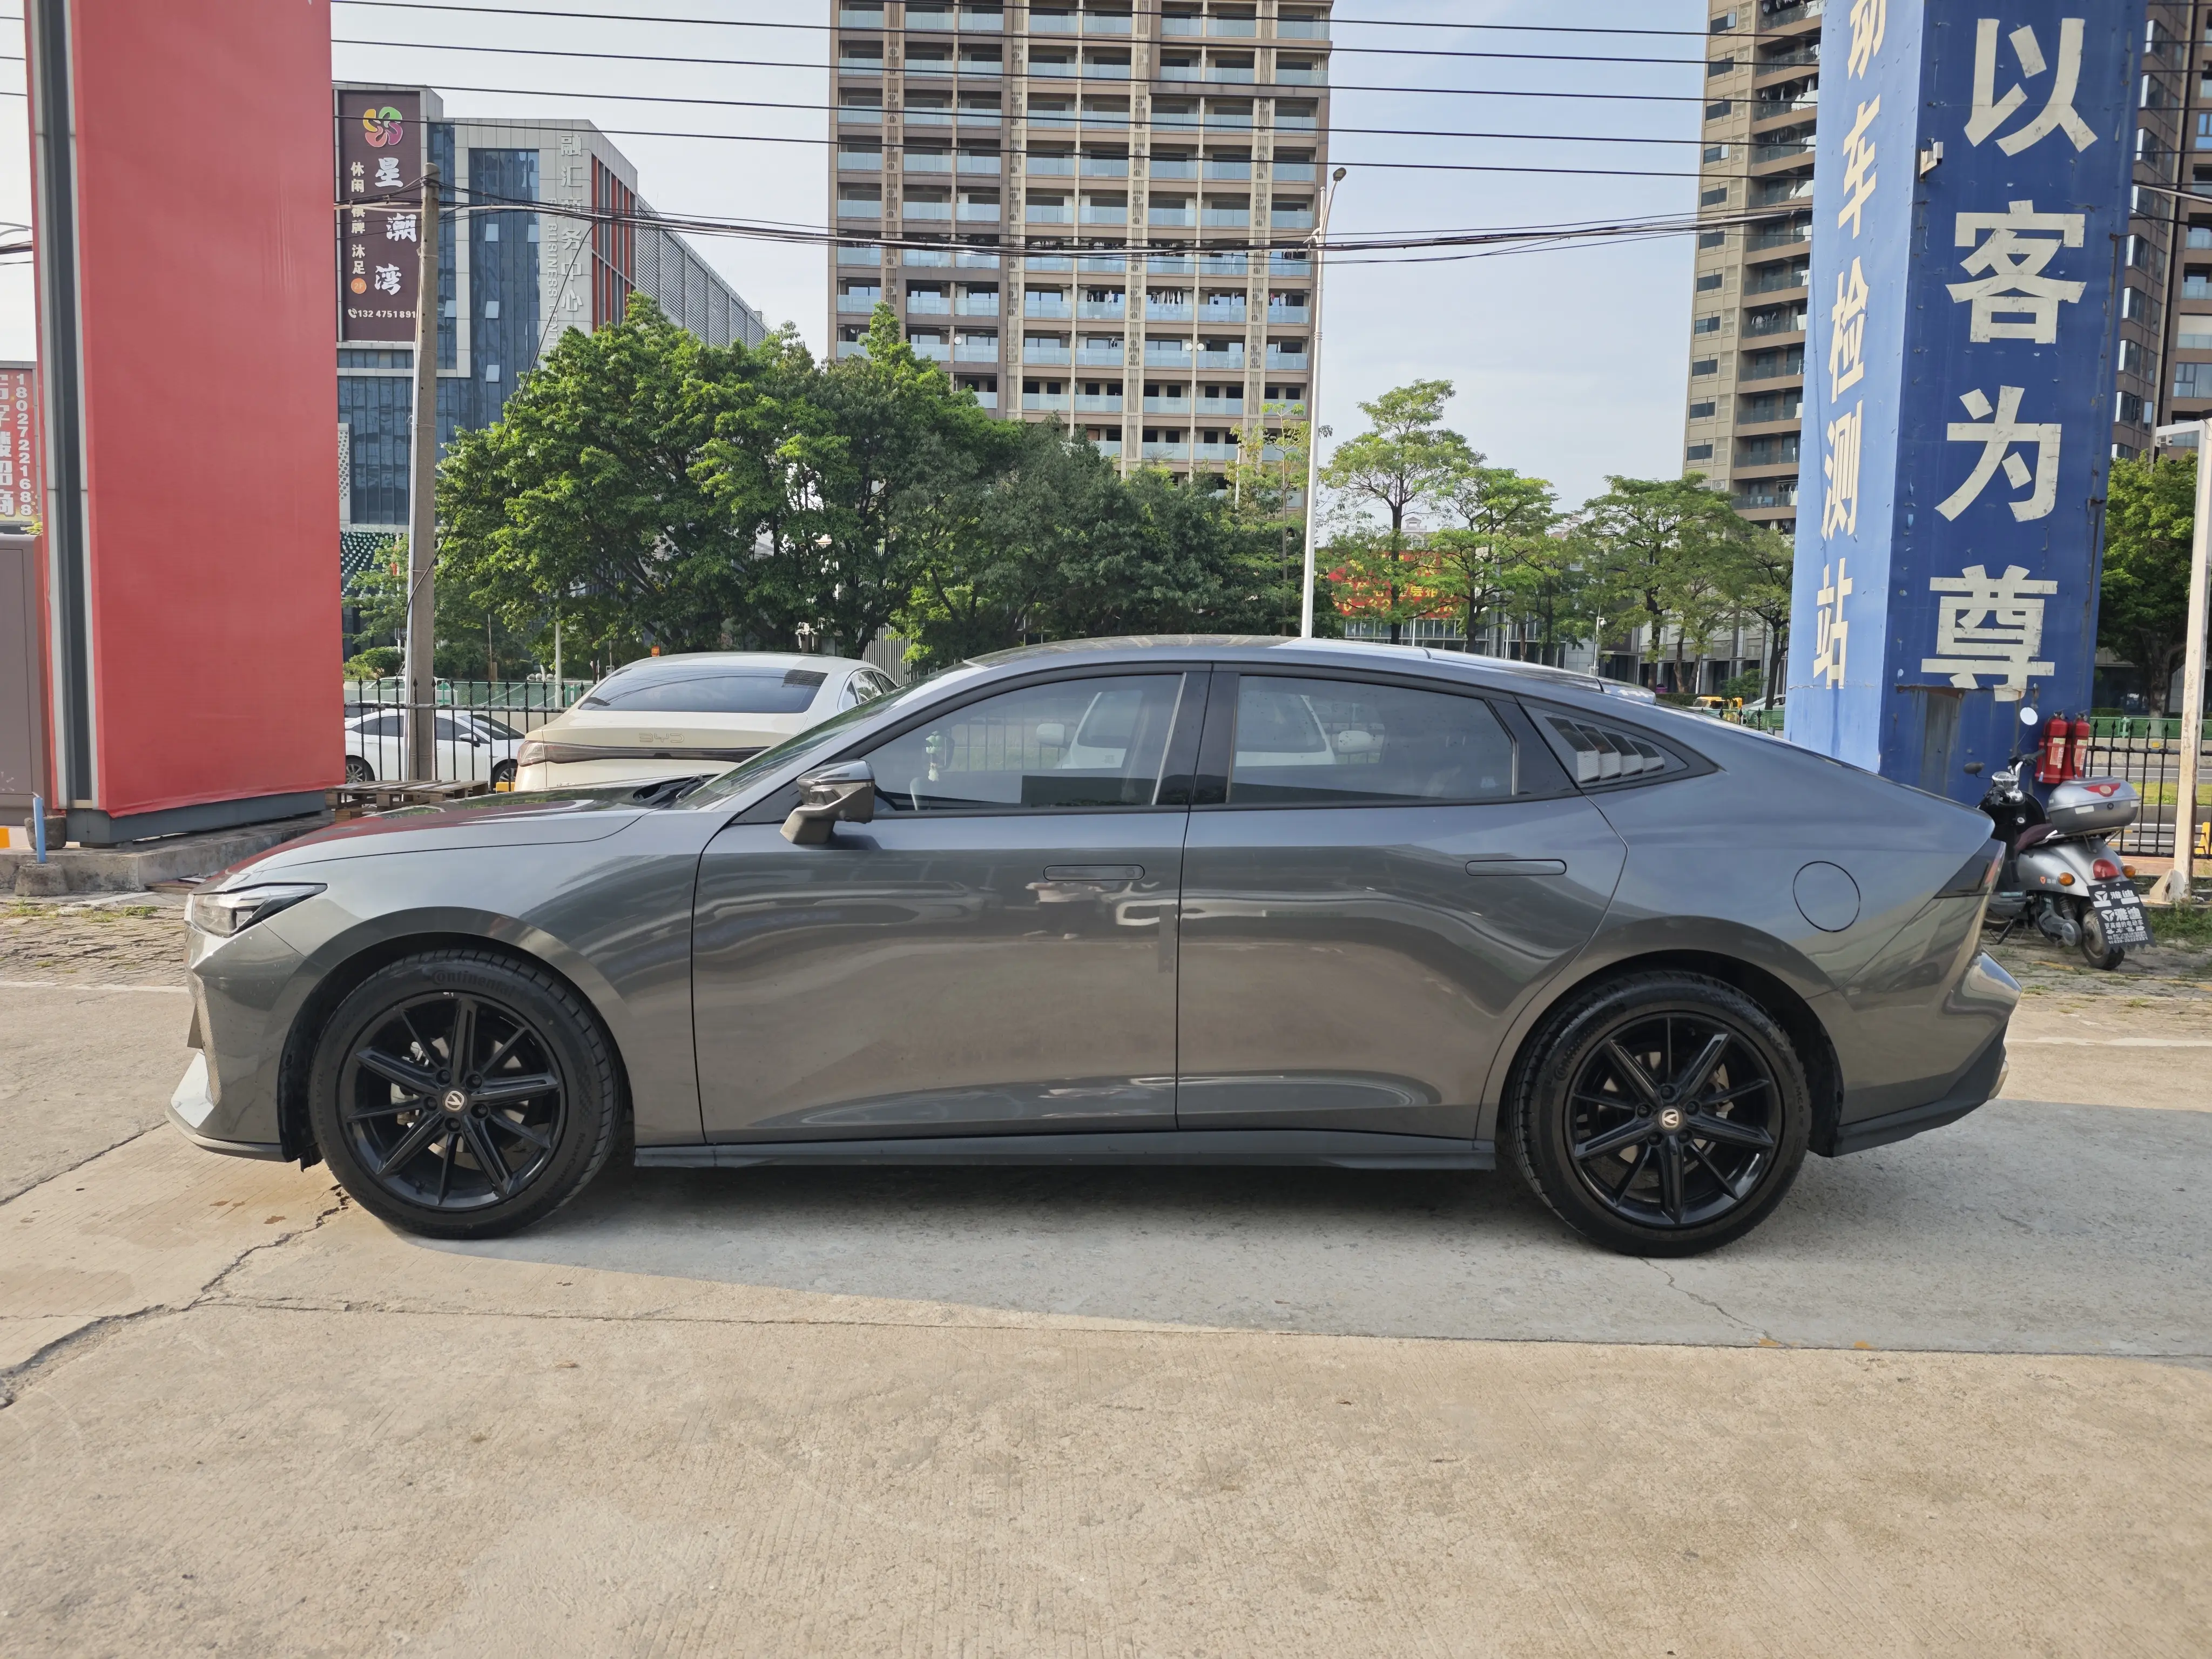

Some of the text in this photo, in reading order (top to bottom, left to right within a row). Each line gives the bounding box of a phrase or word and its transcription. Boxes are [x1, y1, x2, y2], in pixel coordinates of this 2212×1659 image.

[350, 161, 365, 193] 休闲
[375, 157, 417, 295] 星潮湾
[352, 244, 366, 275] 沐足
[547, 222, 558, 298] BUSINESS
[358, 309, 416, 319] 132 4751 891
[547, 304, 558, 350] CENTE
[1921, 18, 2099, 702] 以客为尊
[16, 373, 32, 515] 18027221688
[639, 732, 684, 743] BYD
[433, 969, 516, 999] Continental
